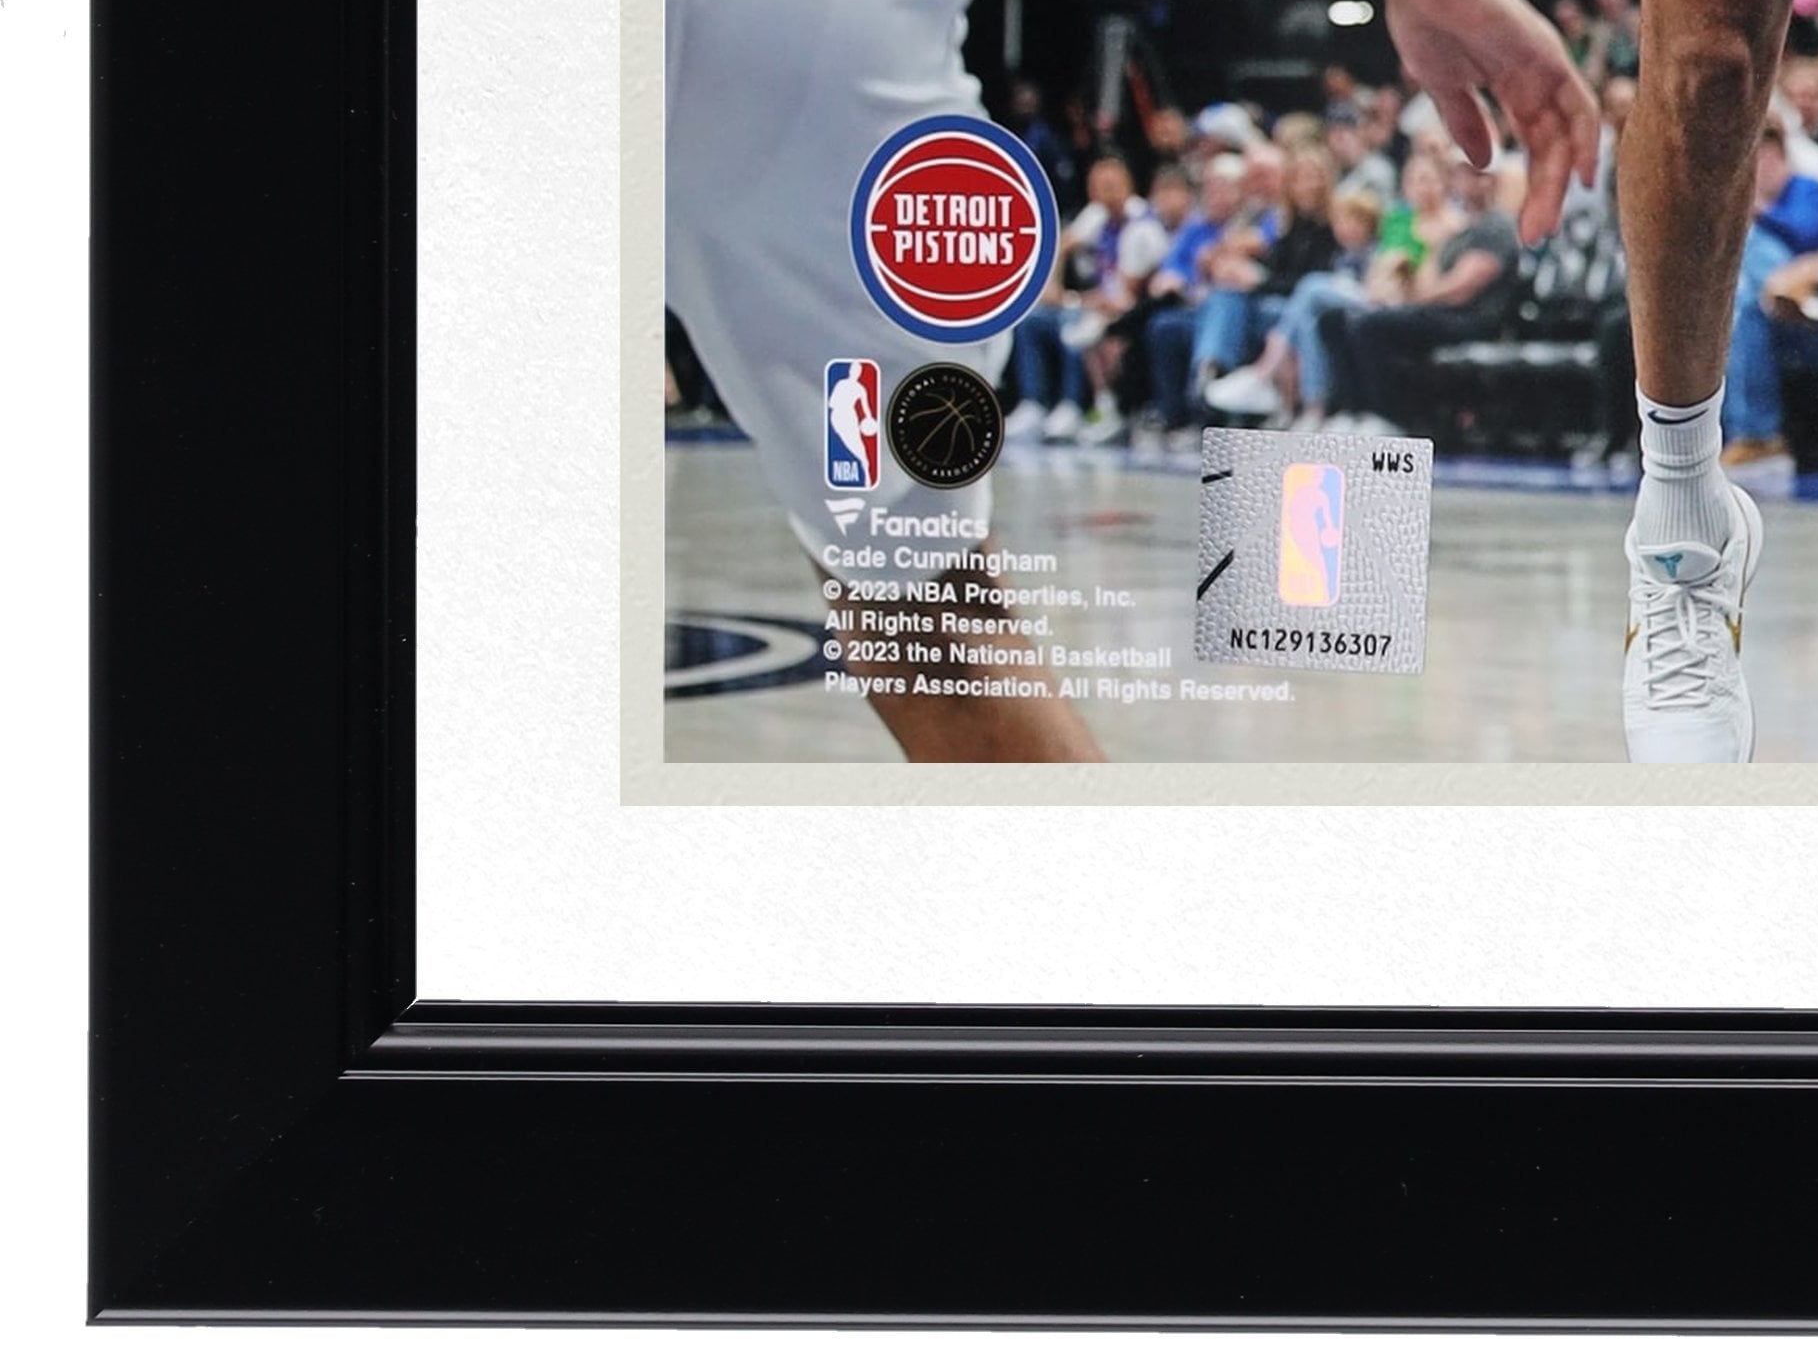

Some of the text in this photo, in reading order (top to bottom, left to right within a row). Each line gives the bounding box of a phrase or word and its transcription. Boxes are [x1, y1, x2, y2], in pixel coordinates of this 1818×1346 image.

[893, 193, 1013, 228] DETROIT
[892, 230, 1015, 265] PISTONS
[832, 461, 860, 482] NBA
[1372, 452, 1415, 474] WWS
[870, 507, 990, 539] Fanatics
[823, 544, 1058, 578] Cade Cunningham
[847, 580, 900, 602] 2023
[906, 582, 957, 603] NBA
[965, 583, 1089, 610] Properties,
[1095, 586, 1137, 607] Inc.
[824, 610, 1054, 636] All Rights Reserved.
[847, 640, 900, 662] 2023
[906, 641, 942, 663] the
[949, 643, 1043, 666] National
[1051, 645, 1172, 668] Basketball
[1230, 628, 1392, 656] NC129136307
[824, 671, 1296, 703] Players Association. All Rights Reserved.
